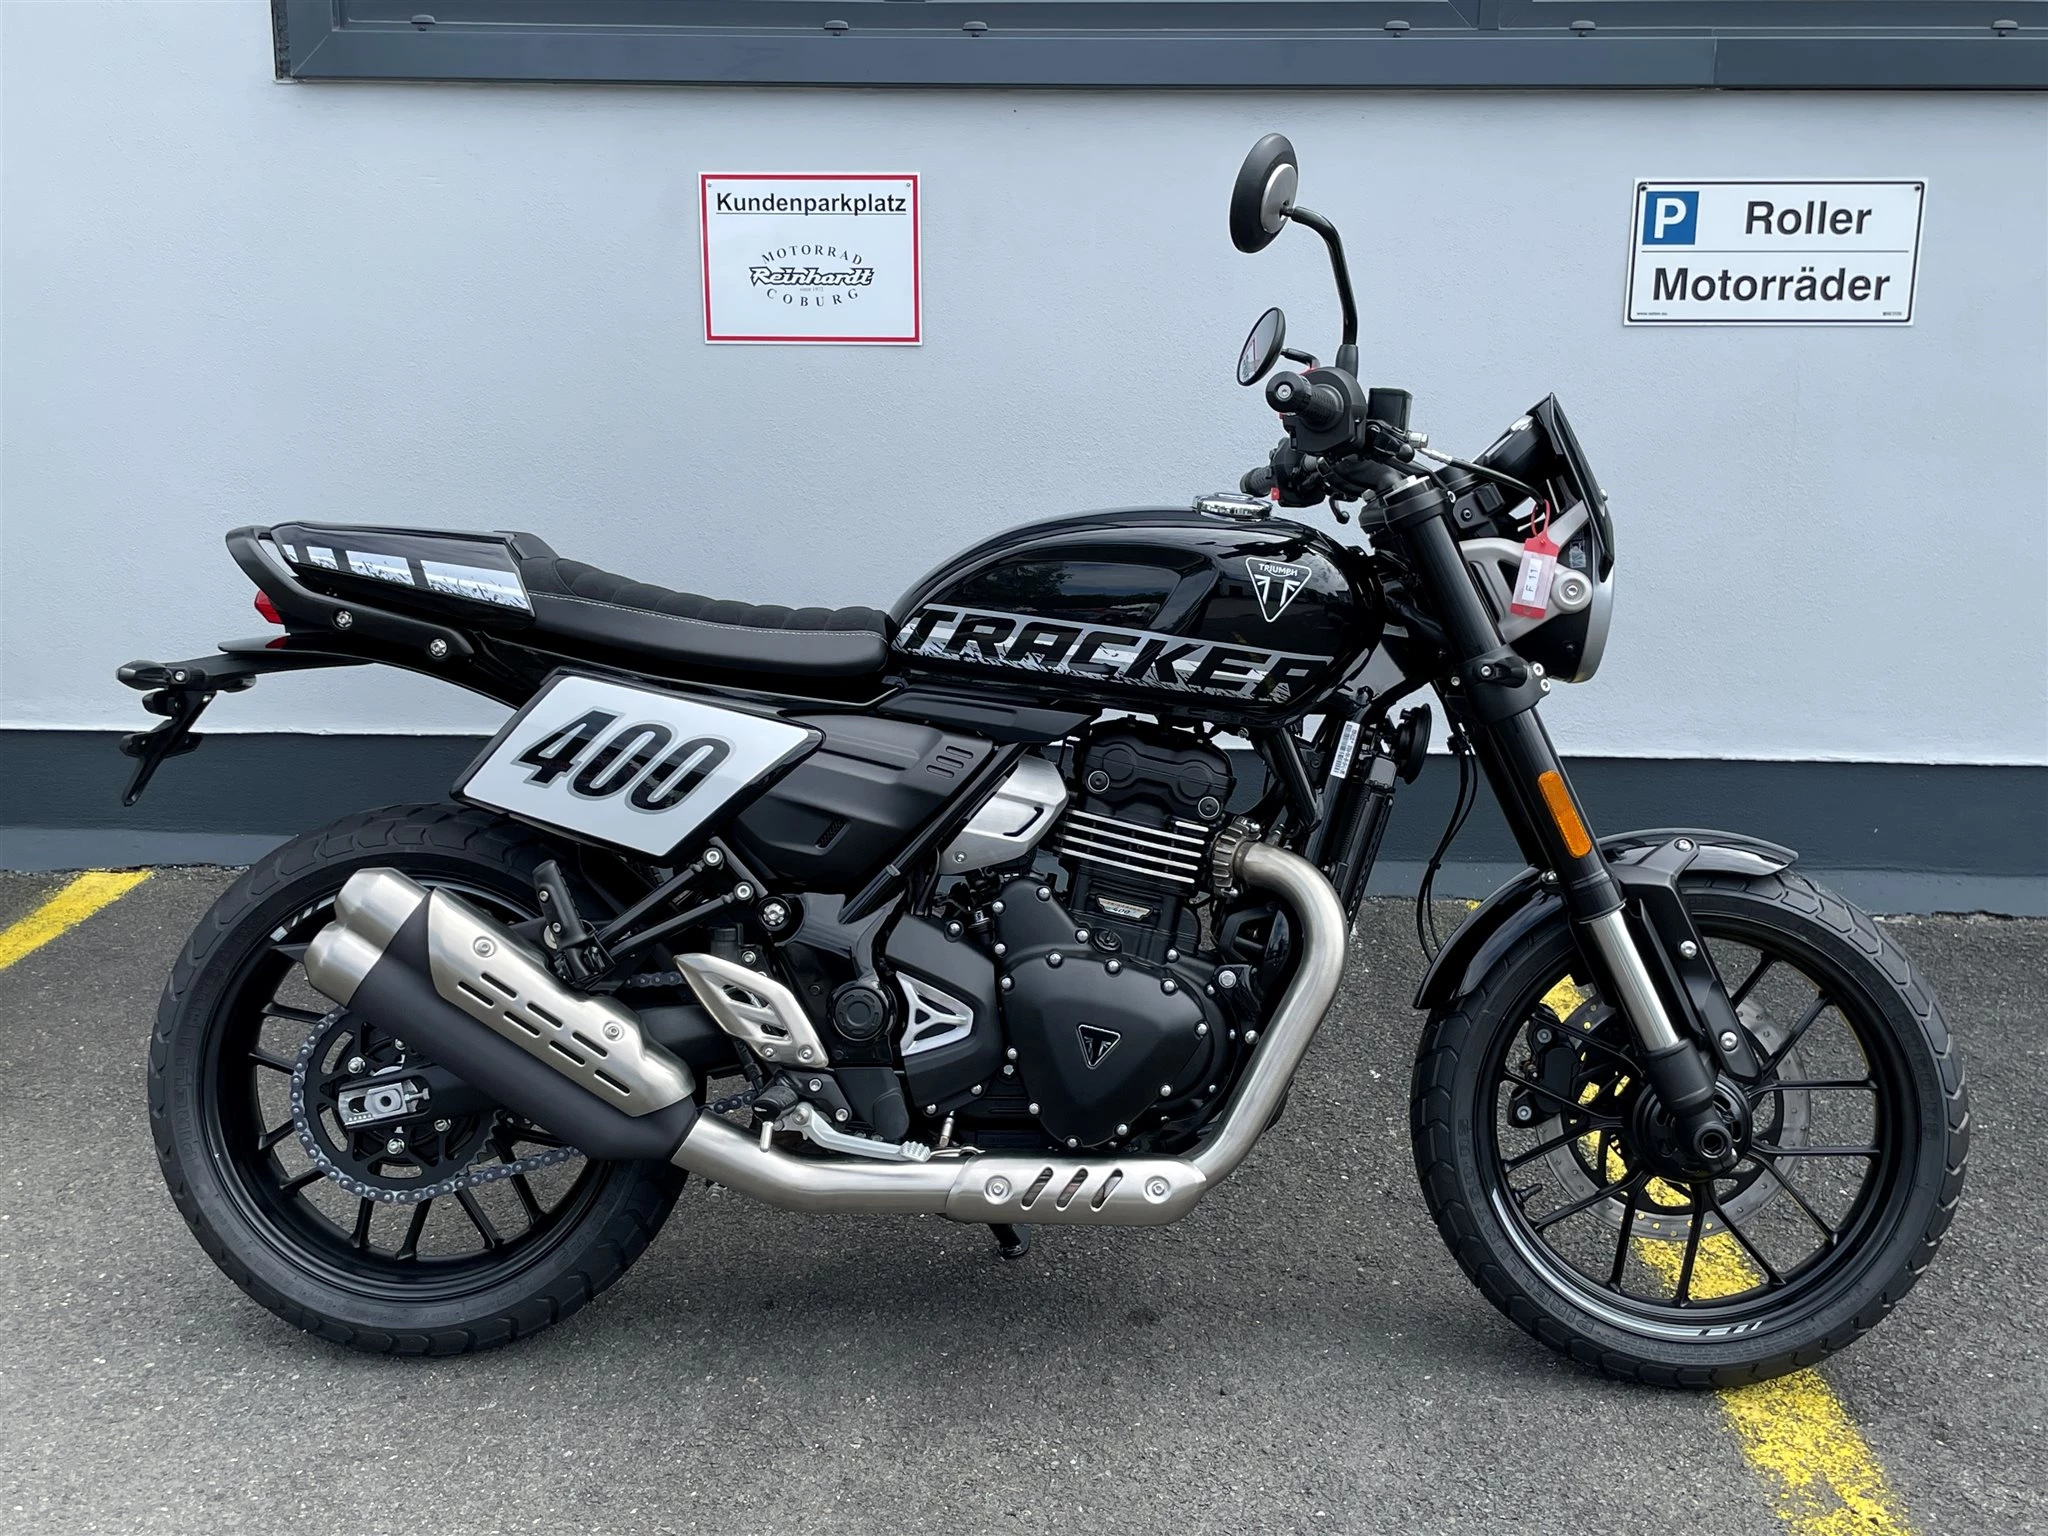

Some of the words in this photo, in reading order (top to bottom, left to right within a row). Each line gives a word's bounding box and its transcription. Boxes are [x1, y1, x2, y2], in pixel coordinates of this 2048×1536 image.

[717, 192, 907, 216] Kundenparkplatz
[1653, 197, 1687, 239] P
[1745, 200, 1873, 235] Roller
[761, 244, 864, 265] MOTORRAD
[749, 266, 875, 286] Reinhardt
[1652, 266, 1891, 301] Motorräder
[766, 288, 859, 307] COBURG
[1258, 563, 1298, 577] TRIUMPH
[911, 606, 1333, 699] TRACKER
[512, 706, 736, 814] 400
